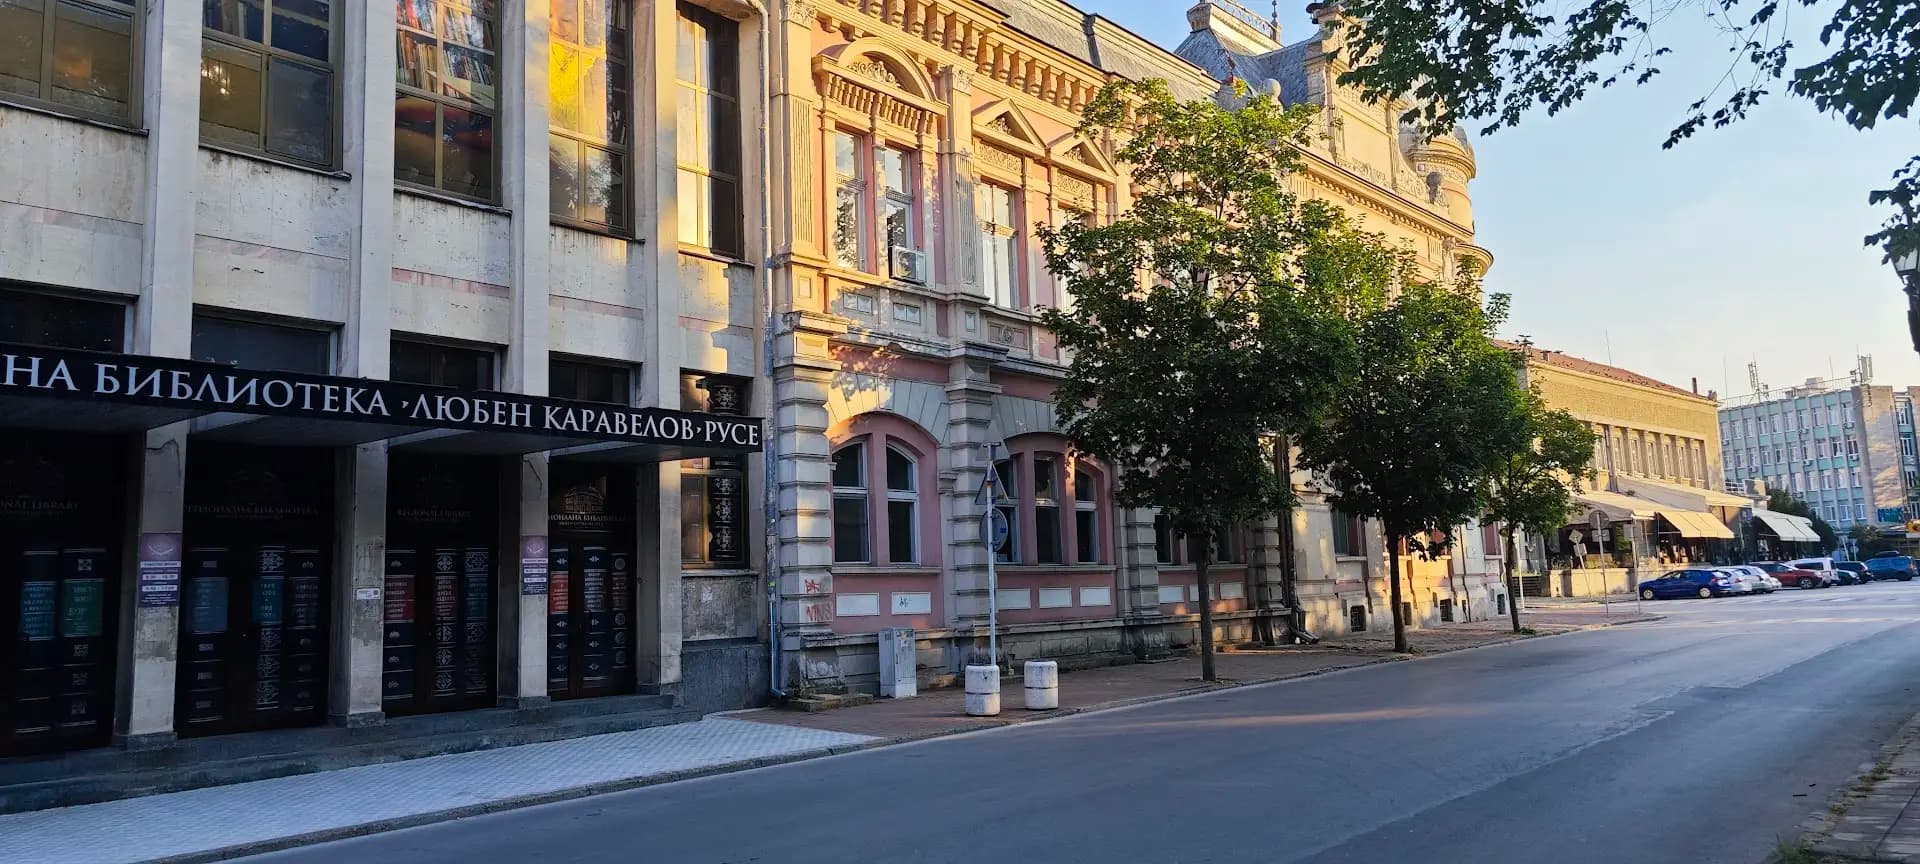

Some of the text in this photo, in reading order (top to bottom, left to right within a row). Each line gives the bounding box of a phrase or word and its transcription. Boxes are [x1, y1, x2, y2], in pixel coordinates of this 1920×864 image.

[2, 354, 80, 391] НА
[94, 362, 391, 417] БИБЛИОТЕКА
[543, 405, 695, 441] КАРАВЕЛОВ
[703, 421, 760, 446] РУСЕ
